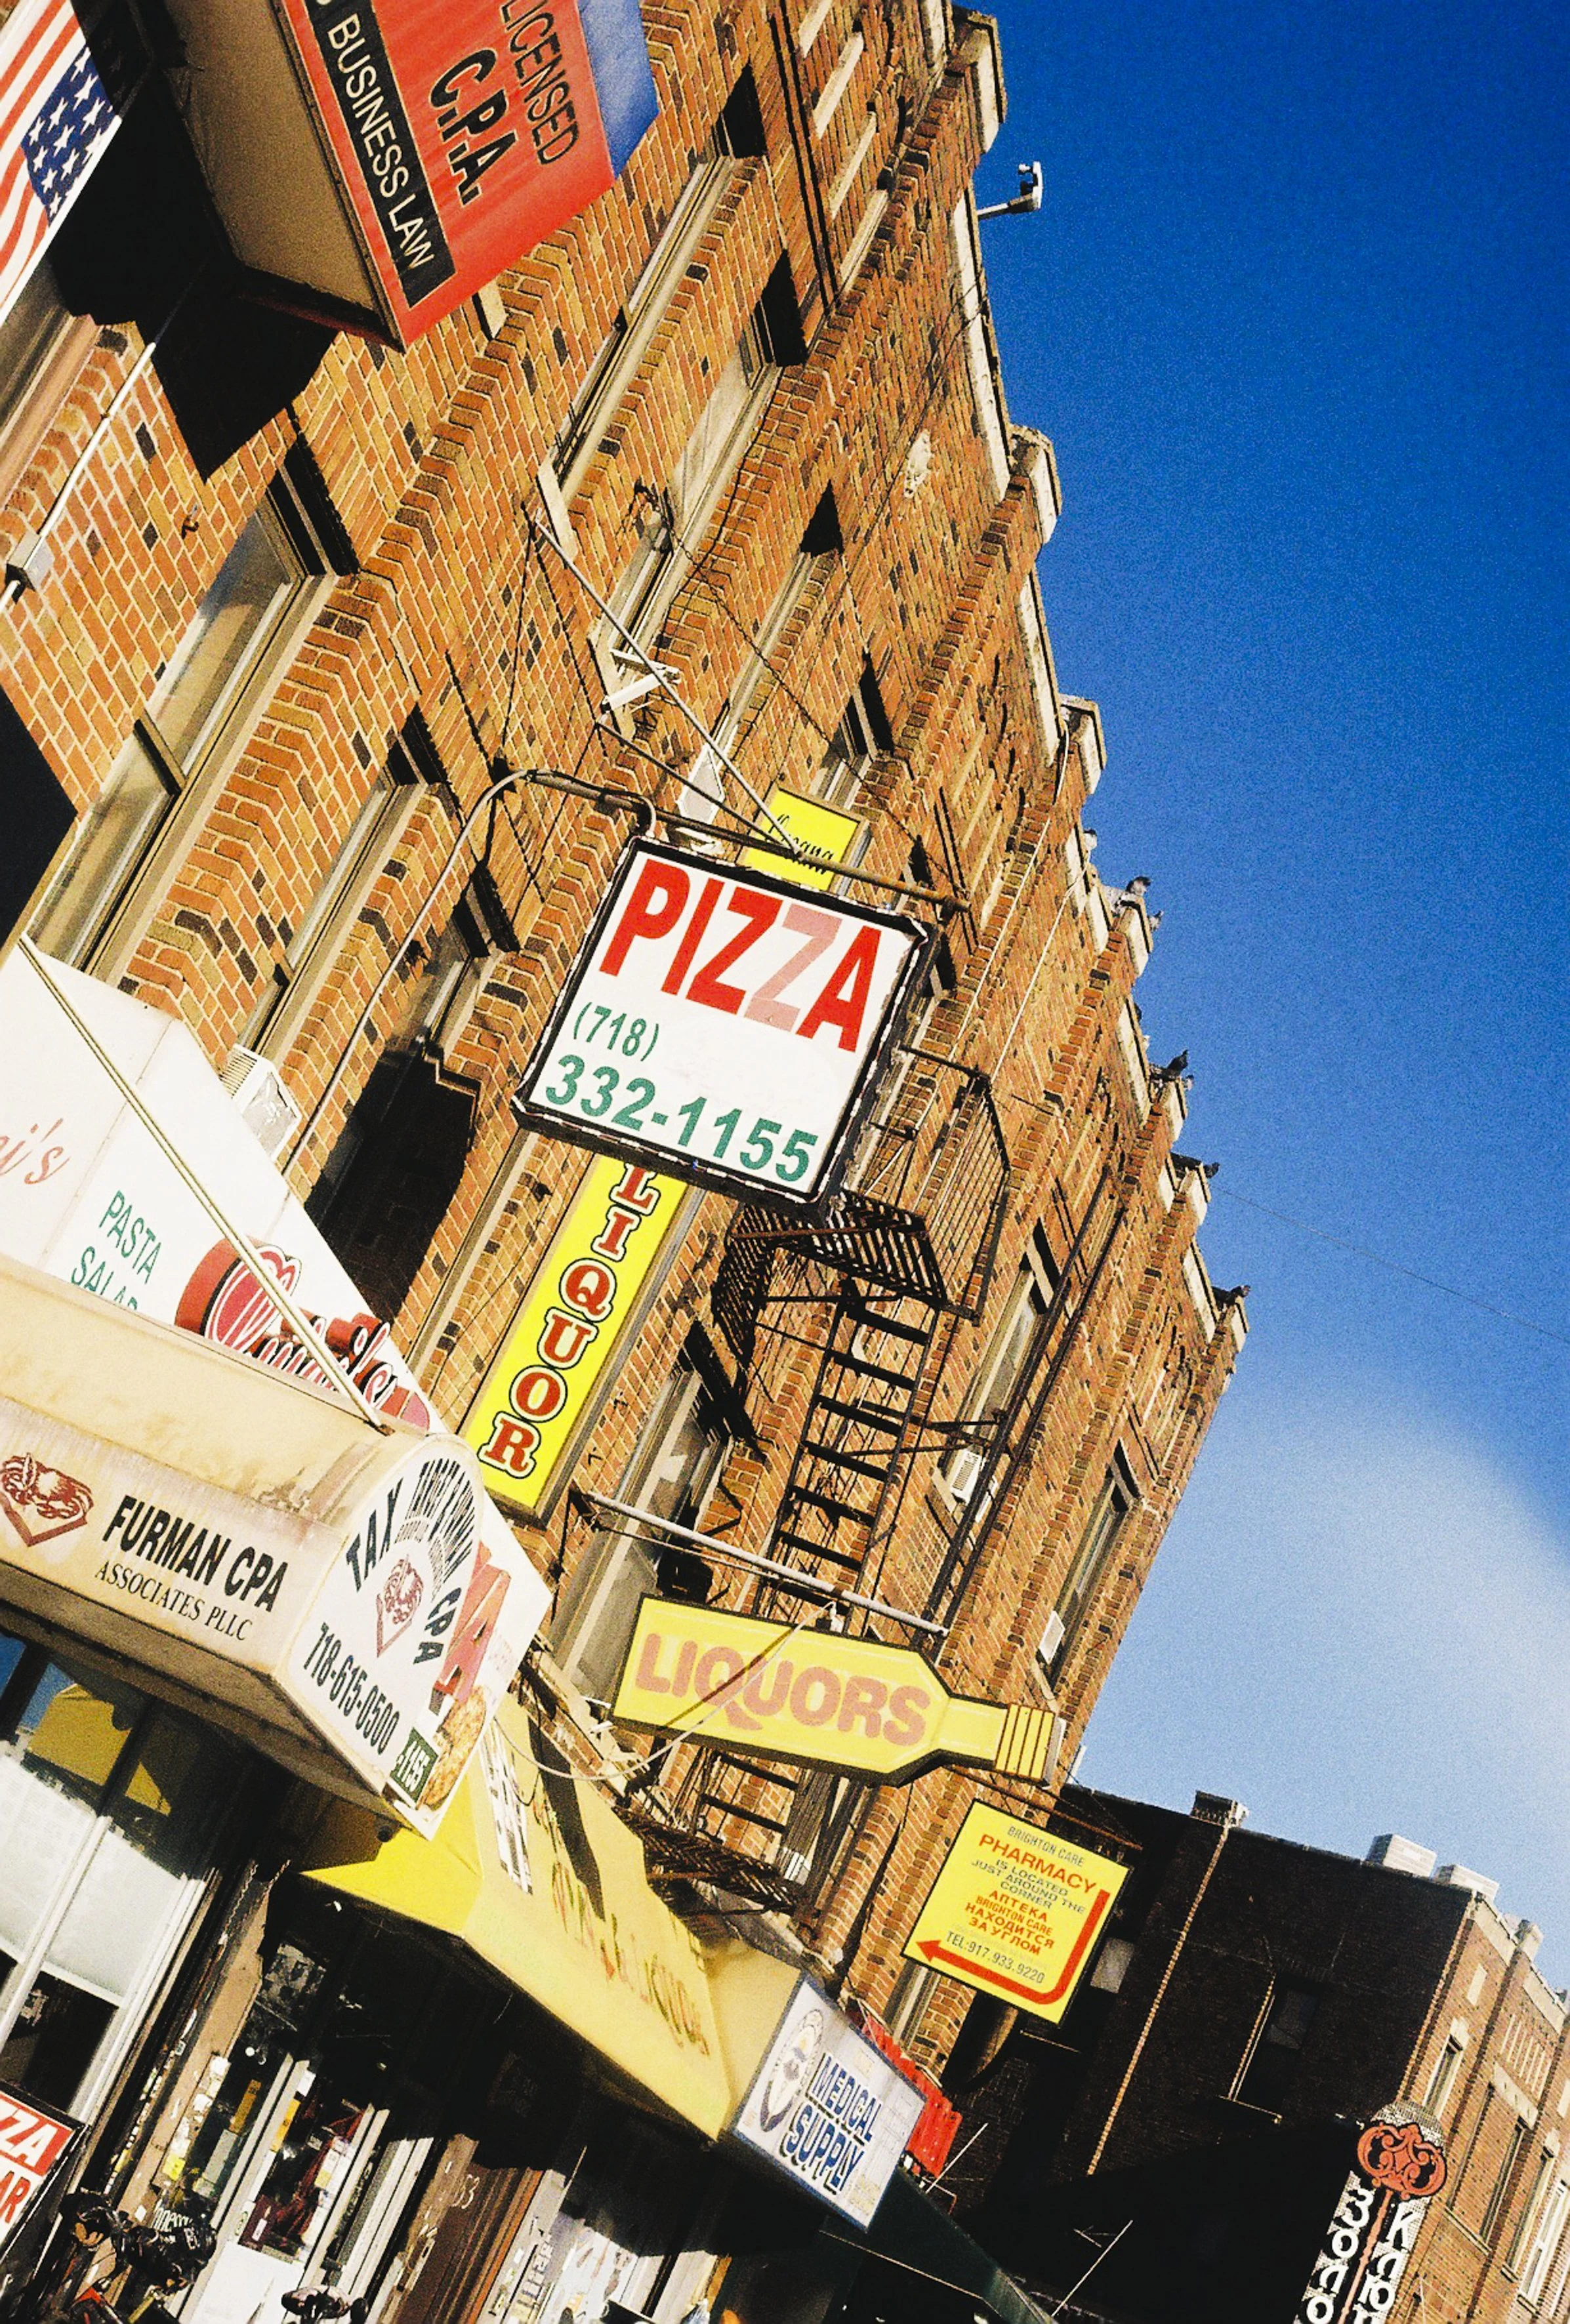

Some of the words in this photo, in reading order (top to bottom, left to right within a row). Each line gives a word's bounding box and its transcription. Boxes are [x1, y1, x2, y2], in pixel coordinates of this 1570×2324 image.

[329, 13, 409, 197] BUSINESS
[390, 195, 435, 269] LAW
[599, 858, 881, 1053] PIZZA
[573, 1002, 659, 1061] (718)
[545, 1054, 817, 1183] 332-1155
[99, 1190, 162, 1284] PASTA
[479, 1162, 659, 1477] LIQUOR
[102, 1494, 232, 1585] FURMAN
[224, 1546, 288, 1612] CPA
[346, 1477, 404, 1593] TAX
[413, 1587, 462, 1665] CPA
[95, 1561, 205, 1620] ASSOCIATES
[205, 1606, 253, 1641] PLLC
[303, 1621, 400, 1755] 718-615-0500
[635, 1633, 931, 1746] LIQUORS
[978, 1834, 1096, 1894] PHARMACY
[996, 1859, 1009, 1869] IS
[1012, 1866, 1069, 1896] LOCATED
[1008, 1825, 1056, 1856] BRIGHTON
[1058, 1847, 1085, 1867] CARE
[964, 1903, 1054, 1949] НАХОДИТСЯ
[971, 1860, 1002, 1877] JUST
[1005, 1875, 1058, 1902] AROUND
[1062, 1898, 1086, 1915] THE
[976, 1895, 1025, 1924] BRIGHTON
[1026, 1917, 1053, 1936] CARE
[989, 1890, 1048, 1922] АПТЕКА
[1000, 1882, 1053, 1909] CORNER
[969, 1916, 989, 1932] ЗА
[990, 1927, 1041, 1955] УГЛОМ
[0, 2099, 58, 2168] ZA
[809, 2054, 882, 2142] MEDICAL
[783, 2103, 865, 2193] SUPPLY
